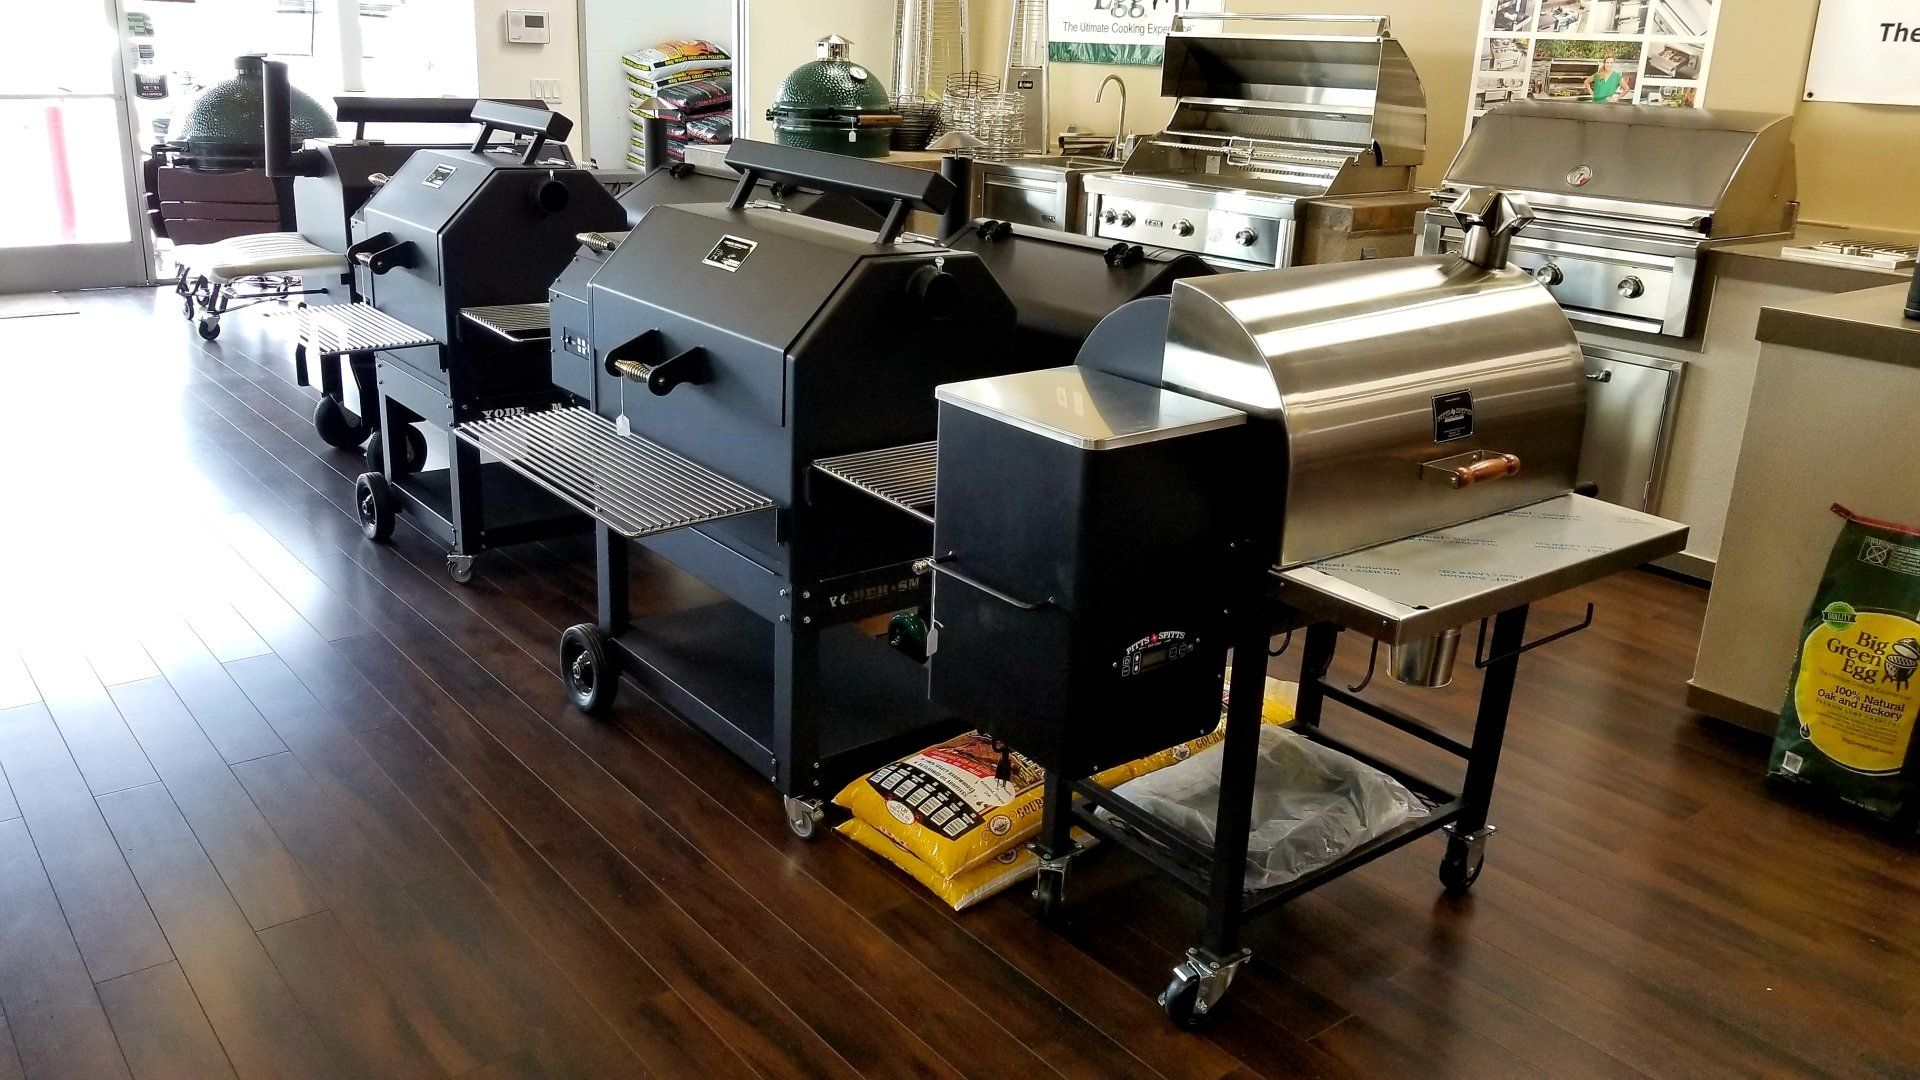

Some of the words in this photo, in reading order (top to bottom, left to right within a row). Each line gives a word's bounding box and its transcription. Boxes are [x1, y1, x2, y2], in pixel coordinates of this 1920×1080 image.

[1064, 22, 1078, 32] The
[1112, 22, 1144, 36] Cooking
[1148, 24, 1192, 35] Experce
[1880, 22, 1920, 42] The
[482, 406, 528, 419] YODE
[1828, 612, 1852, 622] QUALITY
[1126, 636, 1150, 655] PITTS
[1158, 630, 1186, 640] SPITTS
[1827, 638, 1880, 667] Green
[1856, 631, 1889, 656] Big
[1842, 658, 1878, 684] Egg
[1816, 699, 1842, 710] PREMIUM
[1846, 708, 1861, 717] LUMP
[1818, 688, 1836, 702] Oak
[1838, 696, 1858, 708] and
[1860, 702, 1902, 722] Hickory
[1834, 686, 1860, 700] 100%
[1864, 694, 1905, 712] Natural
